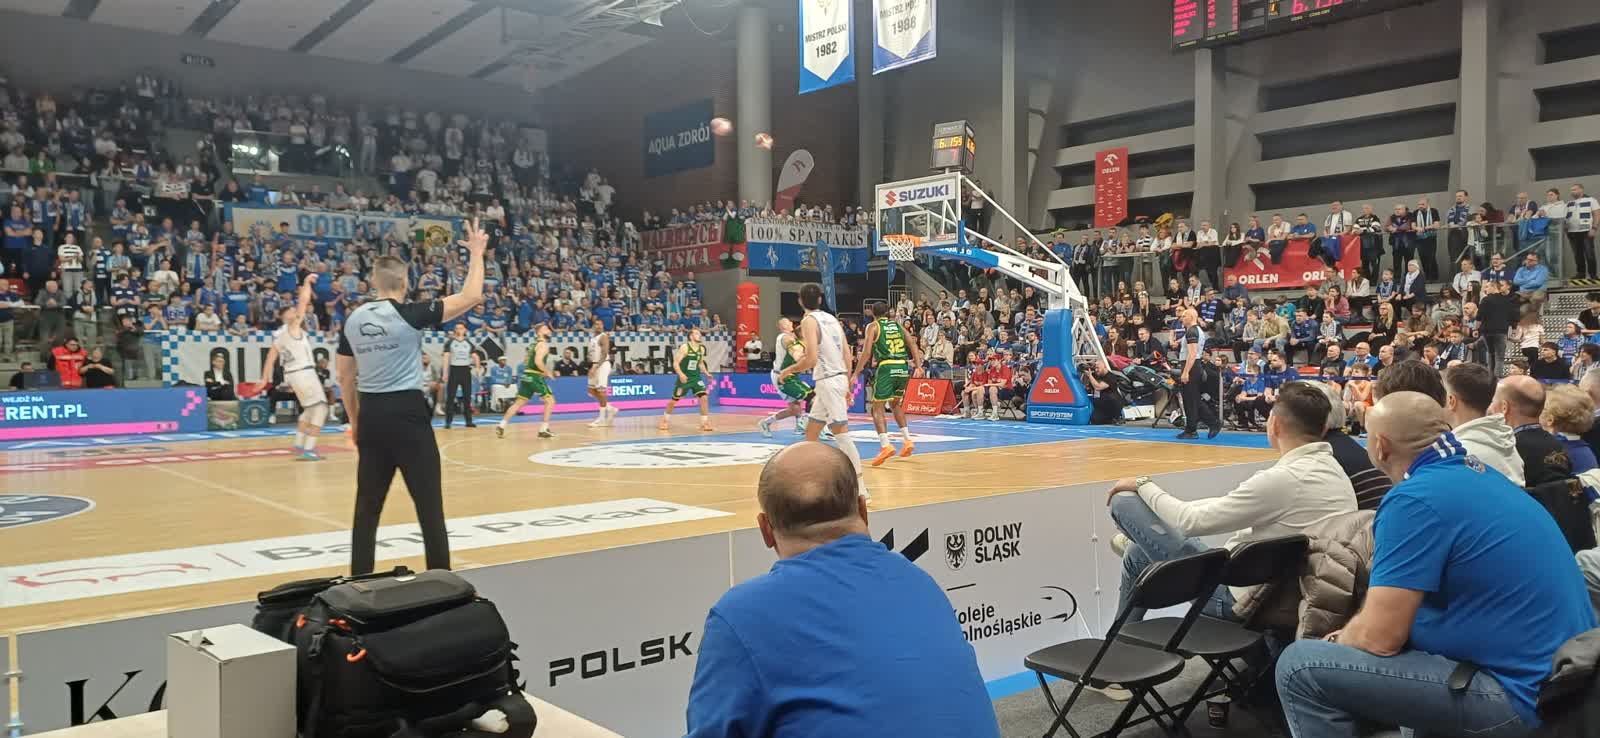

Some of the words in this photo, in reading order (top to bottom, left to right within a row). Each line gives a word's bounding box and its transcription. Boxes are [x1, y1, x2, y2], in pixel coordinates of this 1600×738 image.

[880, 4, 904, 19] MISTRZ
[805, 28, 827, 43] MISTRZ
[827, 23, 848, 37] POLSKI
[816, 40, 838, 58] 1982
[648, 136, 676, 156] AQUA
[678, 121, 710, 147] ZDRÓJ
[1102, 166, 1121, 174] ORLEN
[899, 184, 949, 202] SUZUKI
[750, 227, 783, 241] 100%
[789, 228, 864, 246] SPARTAKUS
[1238, 273, 1279, 285] ORLEN
[1302, 269, 1345, 281] ORLN
[886, 338, 905, 353] 32
[2, 395, 30, 403] WEJDŹ
[907, 403, 920, 411] Bank
[920, 404, 936, 412] Pekao
[472, 503, 681, 535] Pekao
[973, 521, 1023, 546] DOLNY
[974, 540, 1021, 564] ŚLĄSK
[953, 603, 995, 629] oleje
[962, 610, 1042, 642] olnośląskie
[549, 631, 700, 688] POLSK
